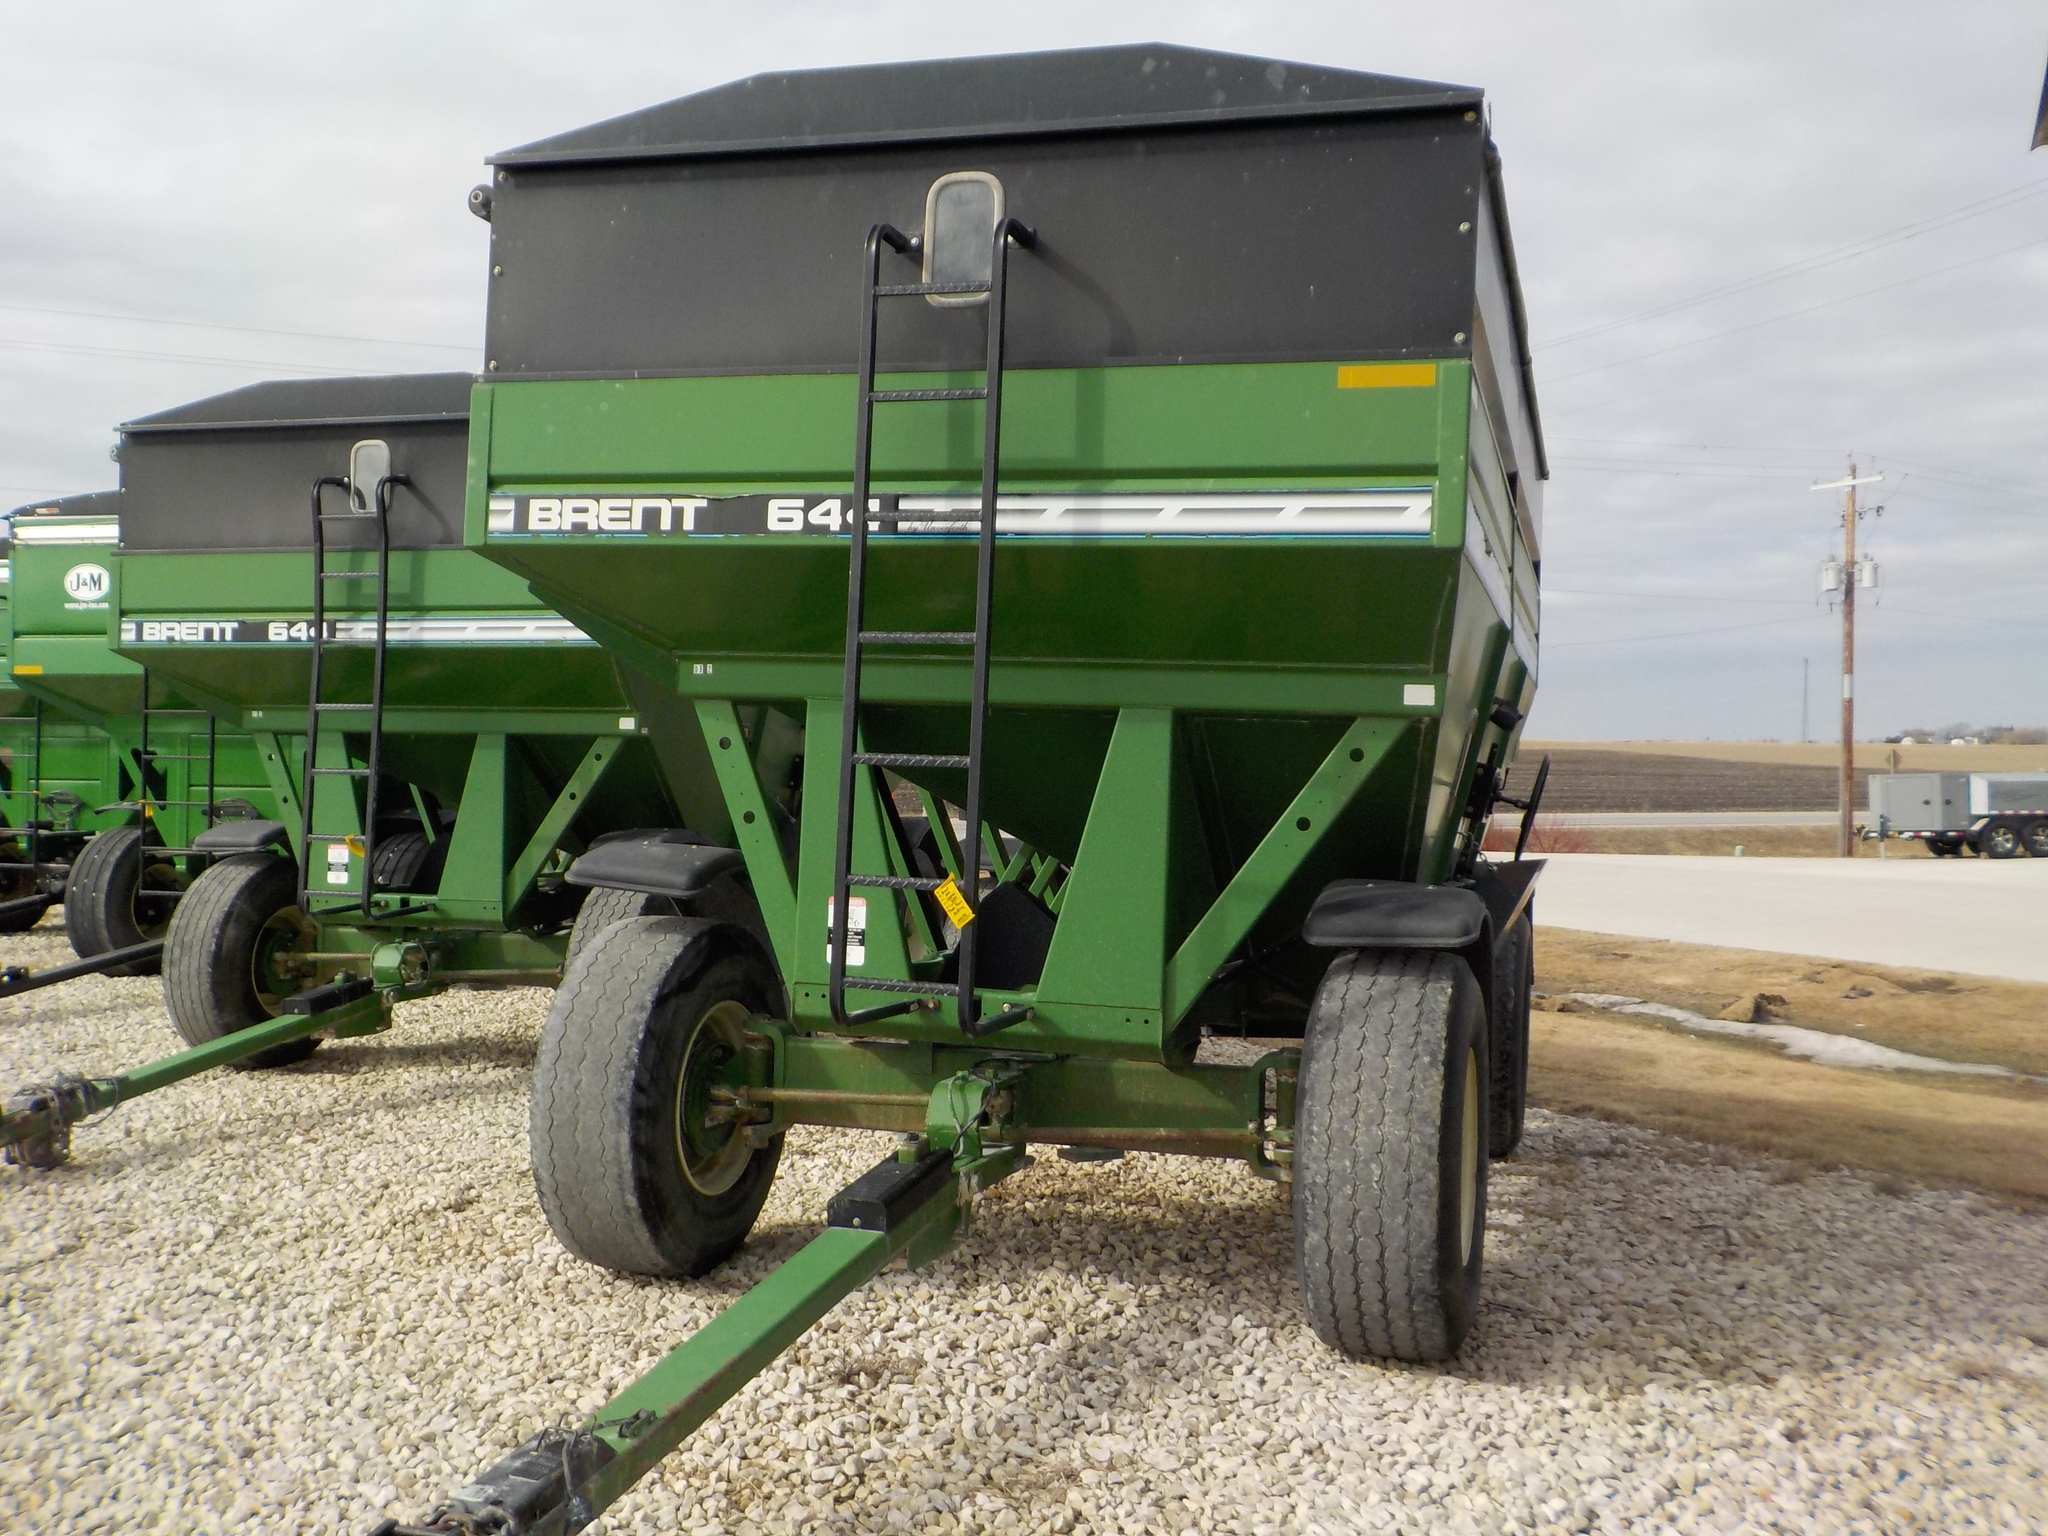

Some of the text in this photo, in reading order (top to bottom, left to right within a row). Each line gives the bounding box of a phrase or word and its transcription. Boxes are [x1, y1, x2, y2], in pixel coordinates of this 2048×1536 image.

[527, 498, 707, 531] BRENT
[70, 572, 103, 592] J&M
[142, 621, 239, 641] BRENT
